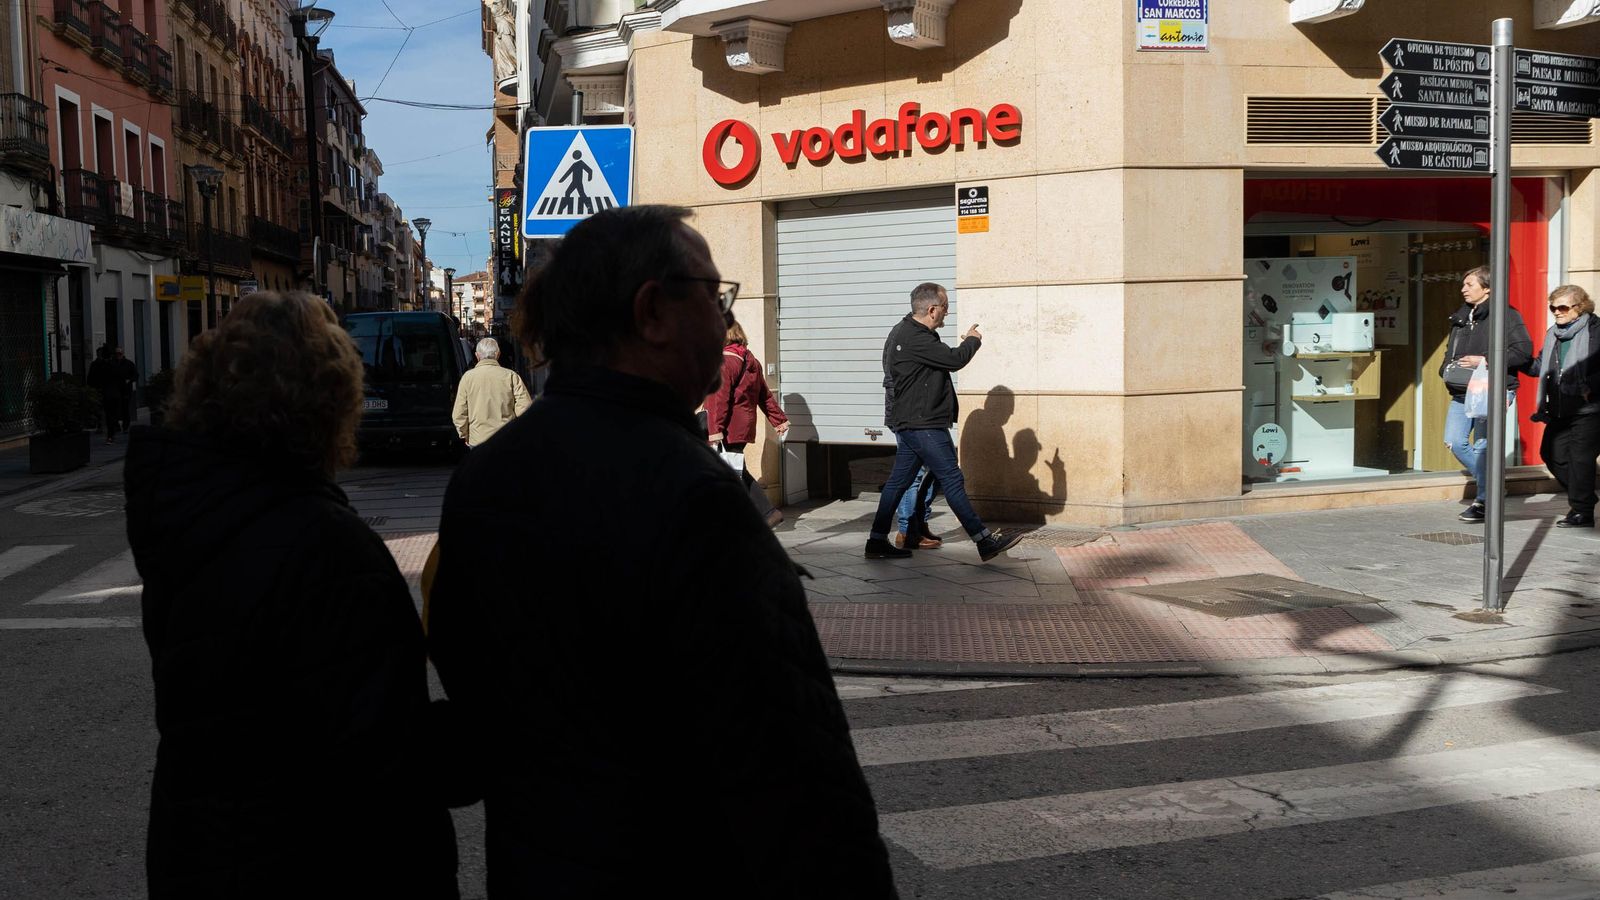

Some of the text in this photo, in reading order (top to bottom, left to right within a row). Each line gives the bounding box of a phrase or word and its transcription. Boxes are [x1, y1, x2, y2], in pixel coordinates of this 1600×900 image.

[1144, 8, 1201, 18] SAN MARCOS
[1160, 30, 1204, 42] antonio
[1407, 43, 1475, 57] OFICINA DE TURISMO
[1433, 57, 1475, 73] EL PÓSITO
[1419, 76, 1474, 89] BASÍLICA MENOR
[1532, 67, 1595, 84] PAISAJE MINERO
[1418, 90, 1474, 105] SANTA MARÍA
[1532, 85, 1558, 96] COSO DE
[1531, 98, 1597, 115] SANTA MARGARITA
[1404, 115, 1473, 130] MUSEO DE RAPHAEL
[771, 101, 1022, 167] vodafone
[1400, 140, 1473, 153] MUSEO ARQUEOLÓGICO
[1422, 154, 1472, 168] DE CÁSTULO
[499, 208, 511, 266] EMANUELE
[1350, 236, 1370, 247] Lowi
